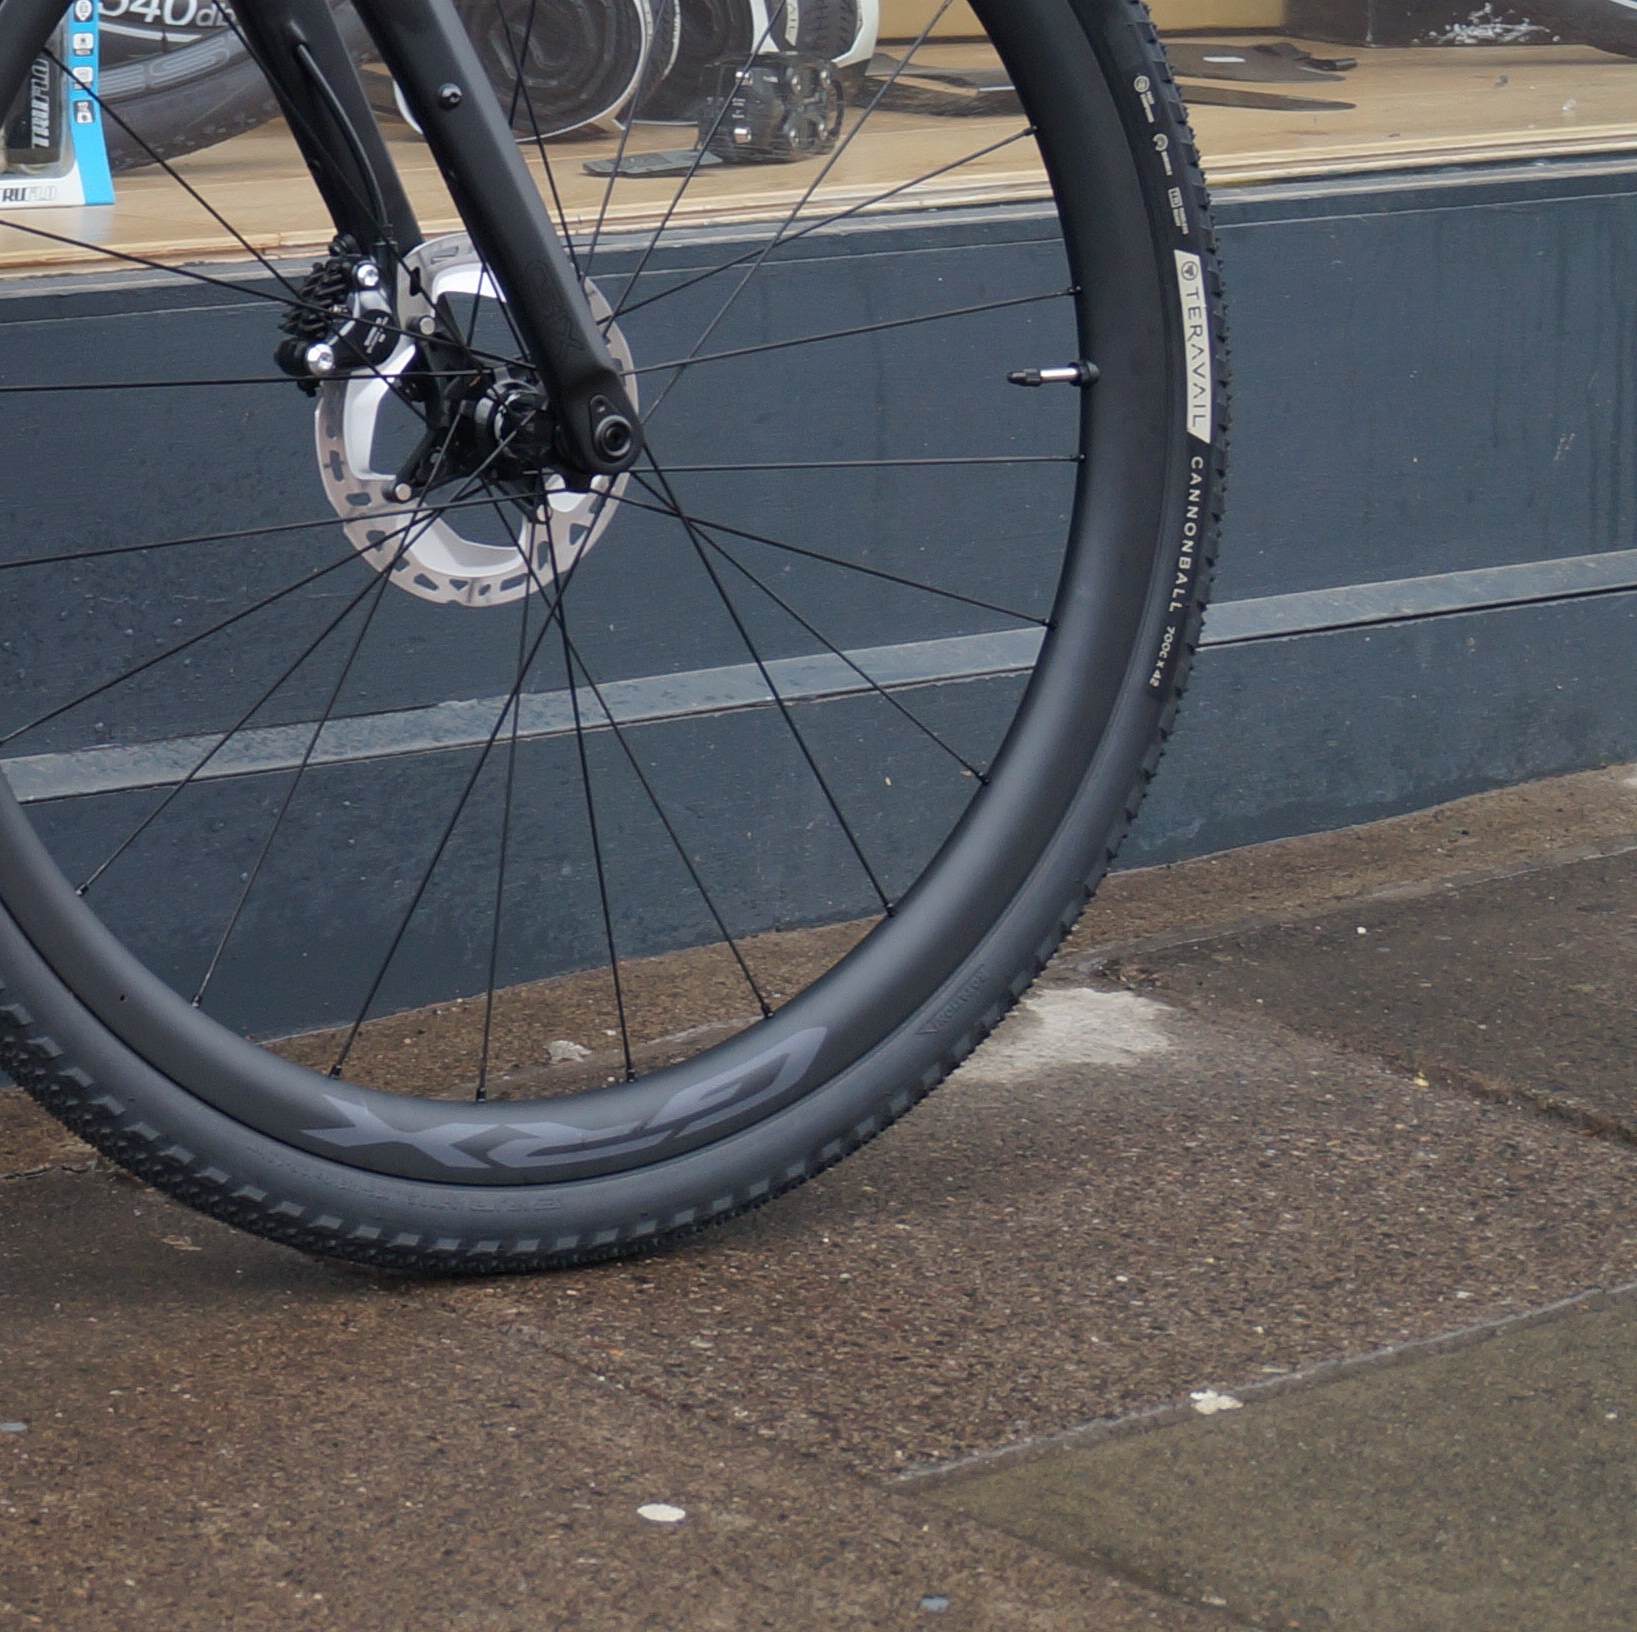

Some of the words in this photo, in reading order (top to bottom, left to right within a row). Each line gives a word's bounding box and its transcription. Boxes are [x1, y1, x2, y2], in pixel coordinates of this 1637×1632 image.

[31, 58, 50, 150] TRUFLO
[1182, 285, 1209, 431] TERAVAIL
[1169, 456, 1204, 613] CANNONBALL
